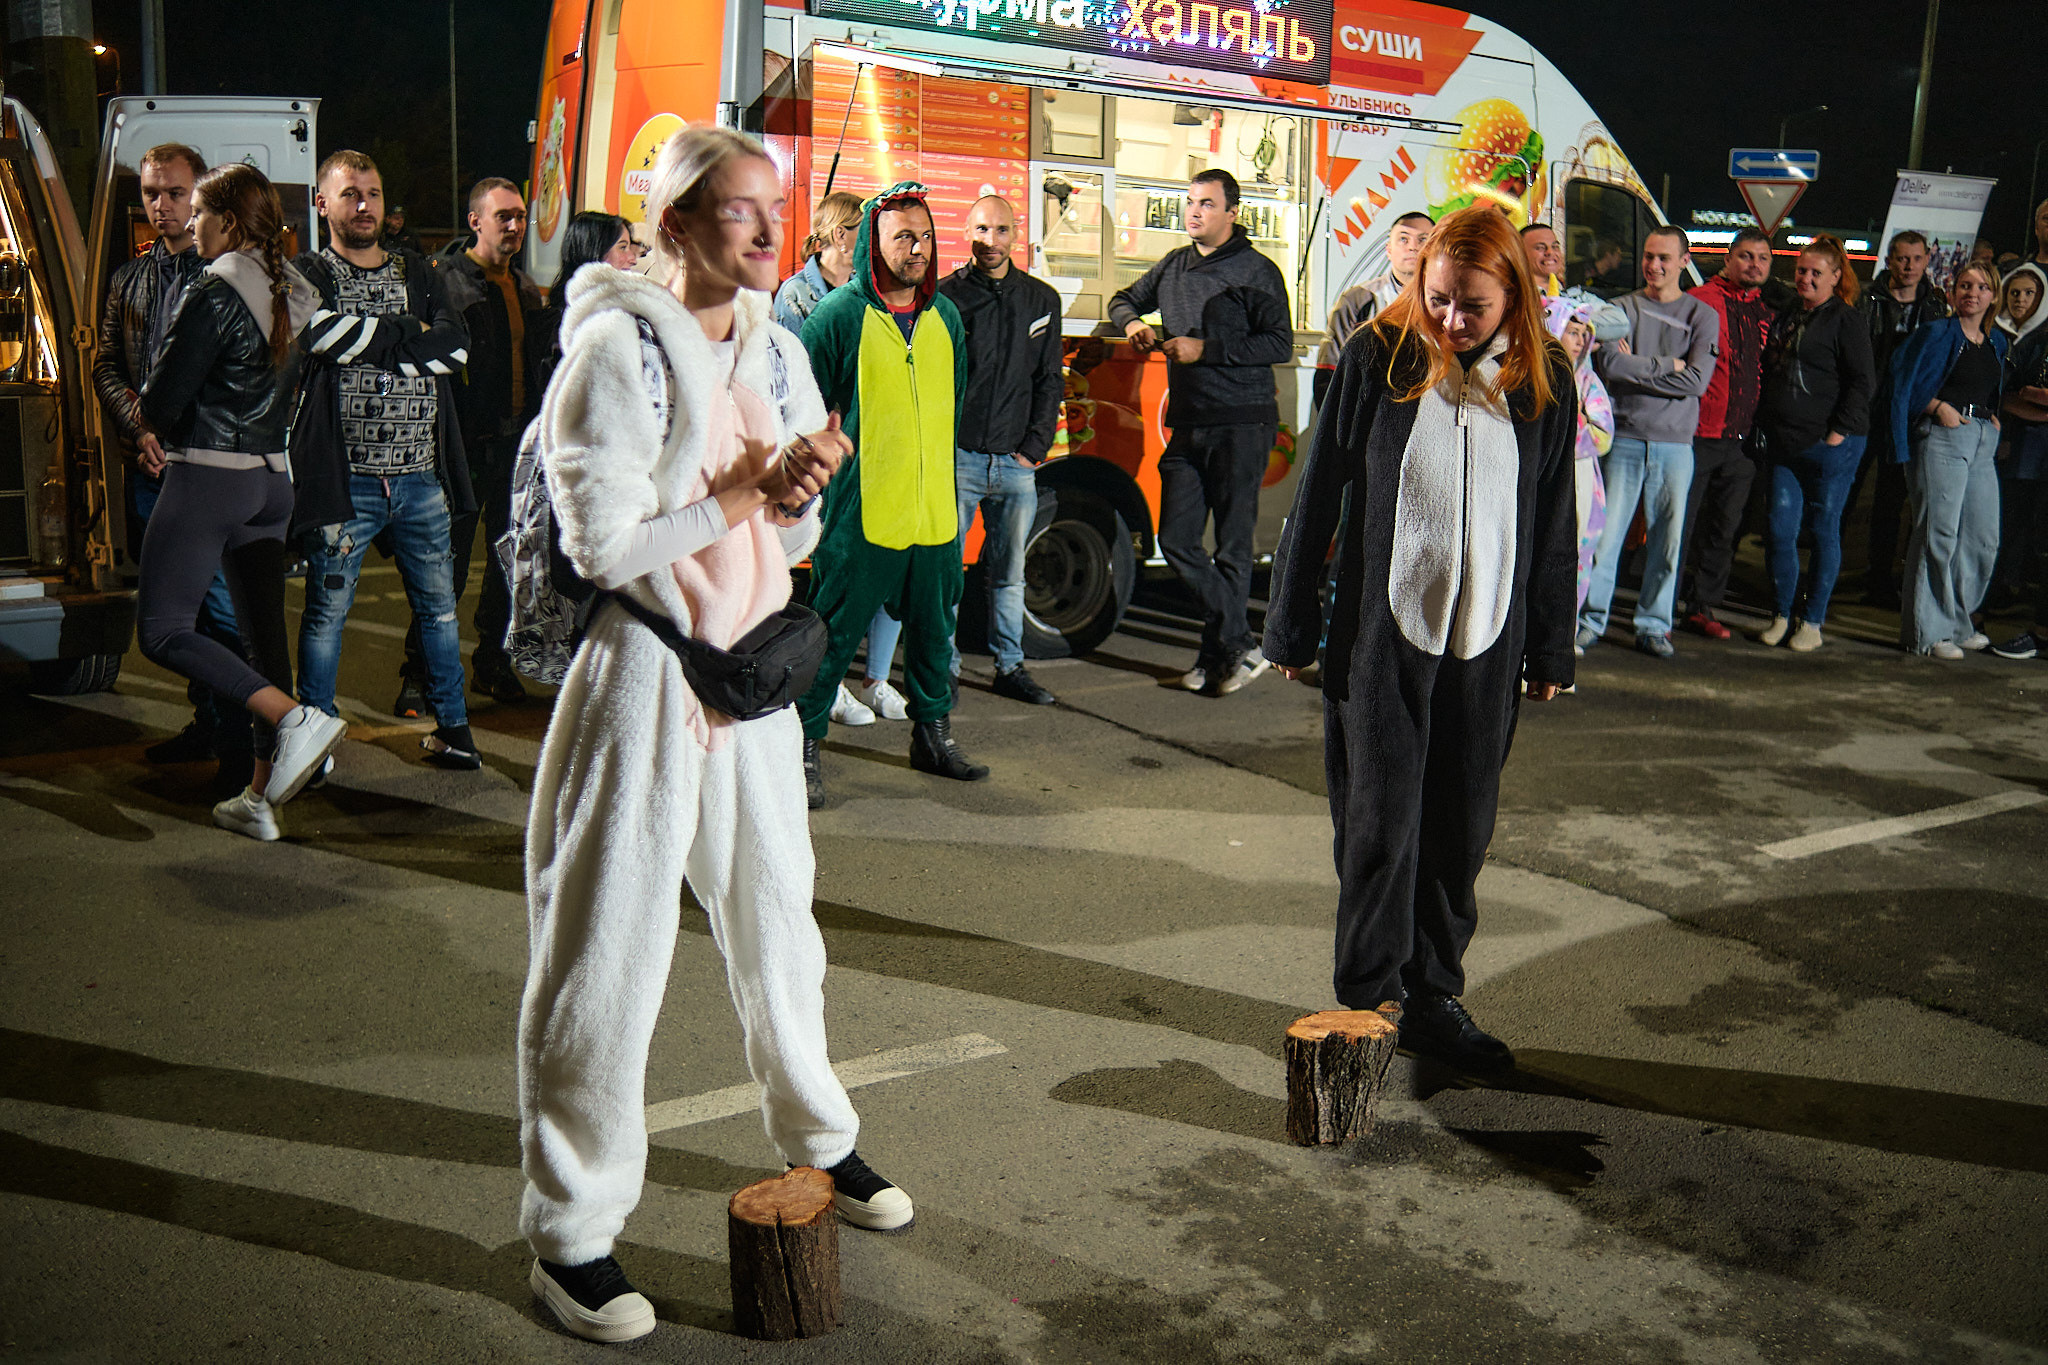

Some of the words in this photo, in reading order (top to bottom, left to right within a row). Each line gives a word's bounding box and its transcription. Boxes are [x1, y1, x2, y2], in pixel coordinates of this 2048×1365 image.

[1338, 24, 1424, 62] СУШИ
[1329, 92, 1412, 116] УЛЫБНИСЬ
[1333, 145, 1417, 258] MIAMI
[1900, 178, 1932, 195] Deller
